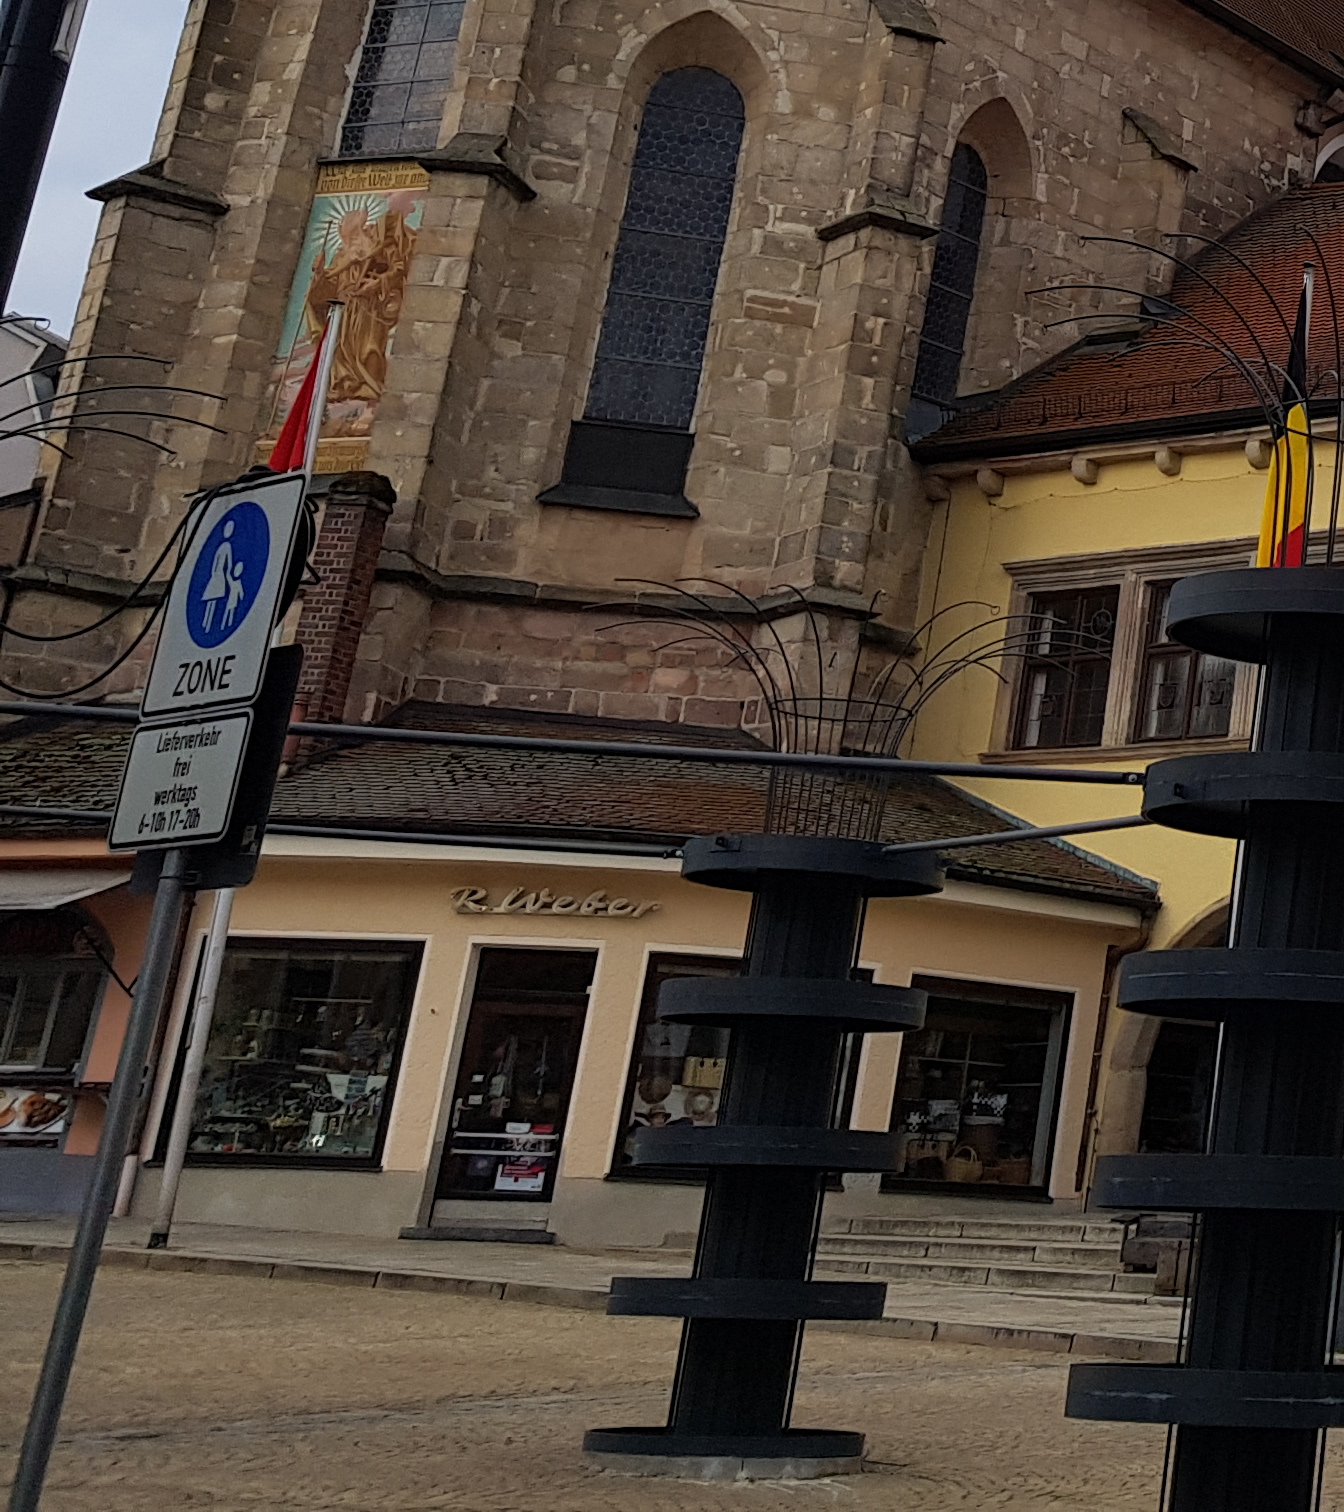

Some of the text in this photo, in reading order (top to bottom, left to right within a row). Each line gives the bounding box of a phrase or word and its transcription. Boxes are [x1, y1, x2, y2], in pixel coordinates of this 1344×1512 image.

[172, 655, 236, 697] ZONE
[156, 725, 222, 754] Lieferverkehr
[172, 755, 192, 778] frei
[154, 784, 198, 808] werktags
[500, 887, 663, 918] Weber
